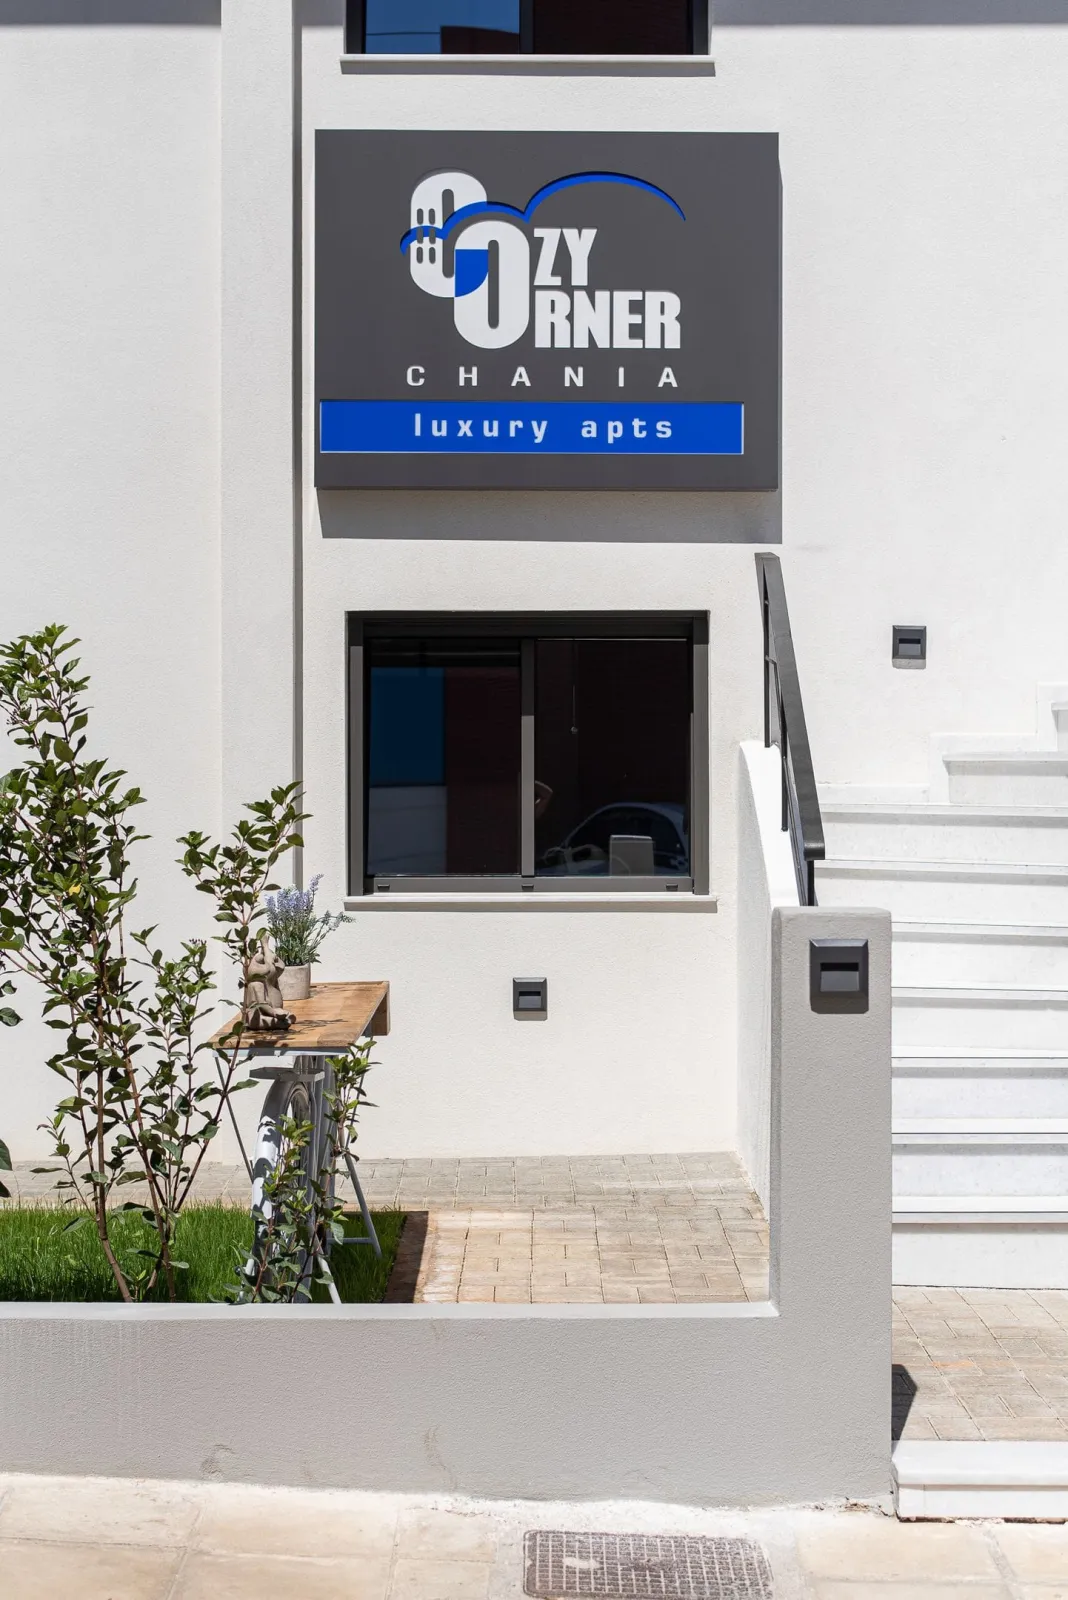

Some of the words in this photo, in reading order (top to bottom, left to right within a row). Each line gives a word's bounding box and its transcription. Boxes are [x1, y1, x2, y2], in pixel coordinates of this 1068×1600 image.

[406, 365, 678, 388] CHANIA
[414, 413, 548, 443] luxury
[580, 418, 673, 444] apts
